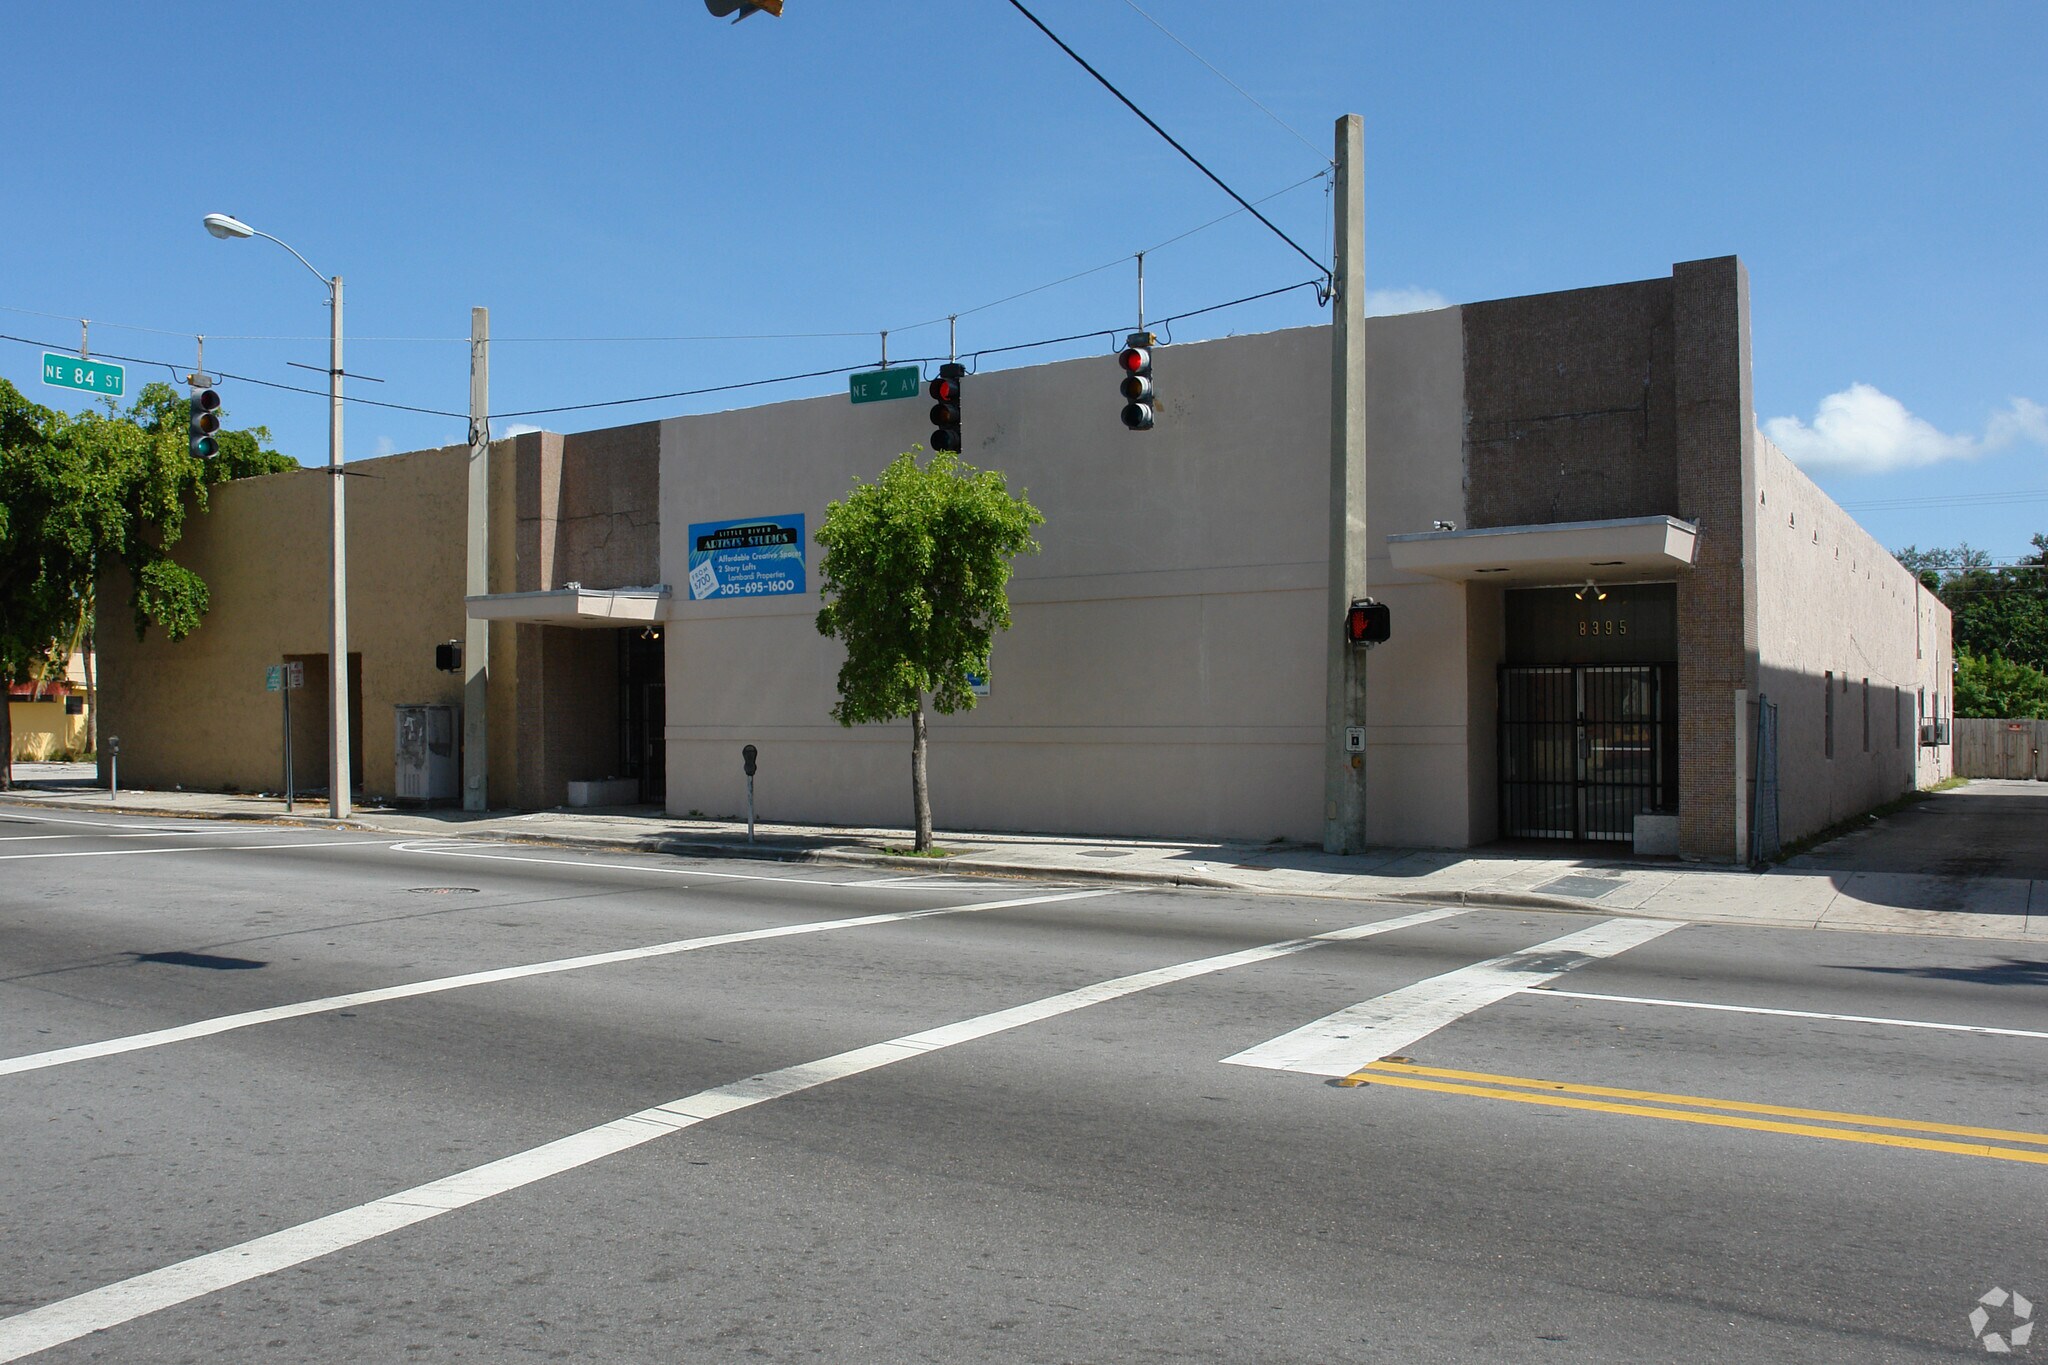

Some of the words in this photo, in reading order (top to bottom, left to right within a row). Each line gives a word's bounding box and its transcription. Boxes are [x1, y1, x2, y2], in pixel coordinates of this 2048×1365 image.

[46, 365, 63, 380] NE
[74, 368, 95, 387] 84
[105, 375, 120, 389] ST
[853, 384, 868, 397] NE
[880, 380, 888, 396] 2
[901, 378, 916, 391] AV
[704, 537, 744, 549] ARTISTS'
[749, 533, 788, 545] STUDIOS
[719, 529, 742, 537] LITTLE
[718, 553, 750, 562] Affordable
[752, 551, 778, 560] Creative
[779, 550, 802, 559] Spaces
[691, 566, 708, 581] FROM
[724, 565, 740, 573] Story
[742, 563, 756, 571] Lofts
[728, 572, 755, 581] Lombardi
[756, 571, 785, 580] Properties
[694, 573, 711, 590] $700
[720, 579, 794, 595] 305-695-1600
[1579, 619, 1627, 636] 8395
